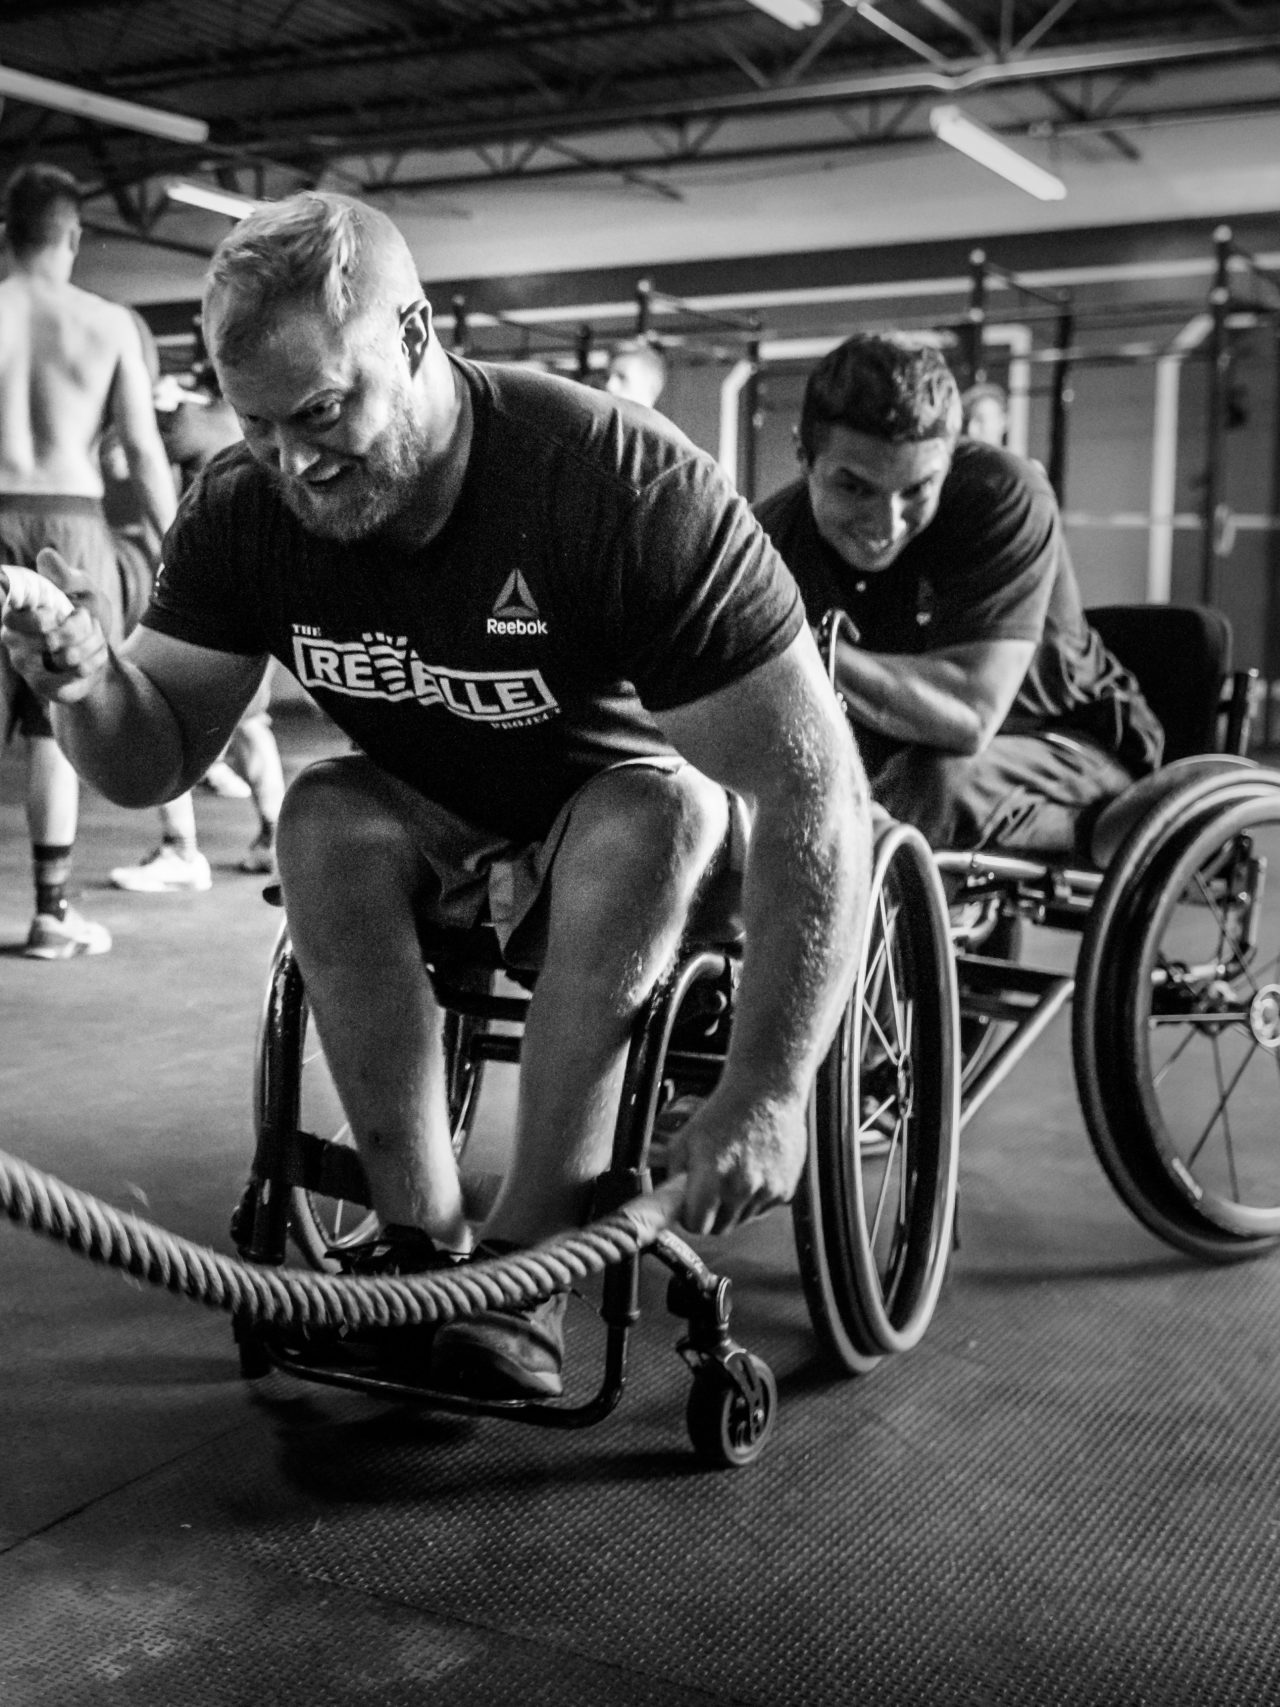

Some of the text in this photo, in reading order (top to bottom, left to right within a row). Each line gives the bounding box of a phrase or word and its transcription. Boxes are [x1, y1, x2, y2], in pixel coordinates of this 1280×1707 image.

[292, 623, 321, 637] THE
[487, 618, 548, 635] Reebok
[310, 636, 536, 714] REELLE
